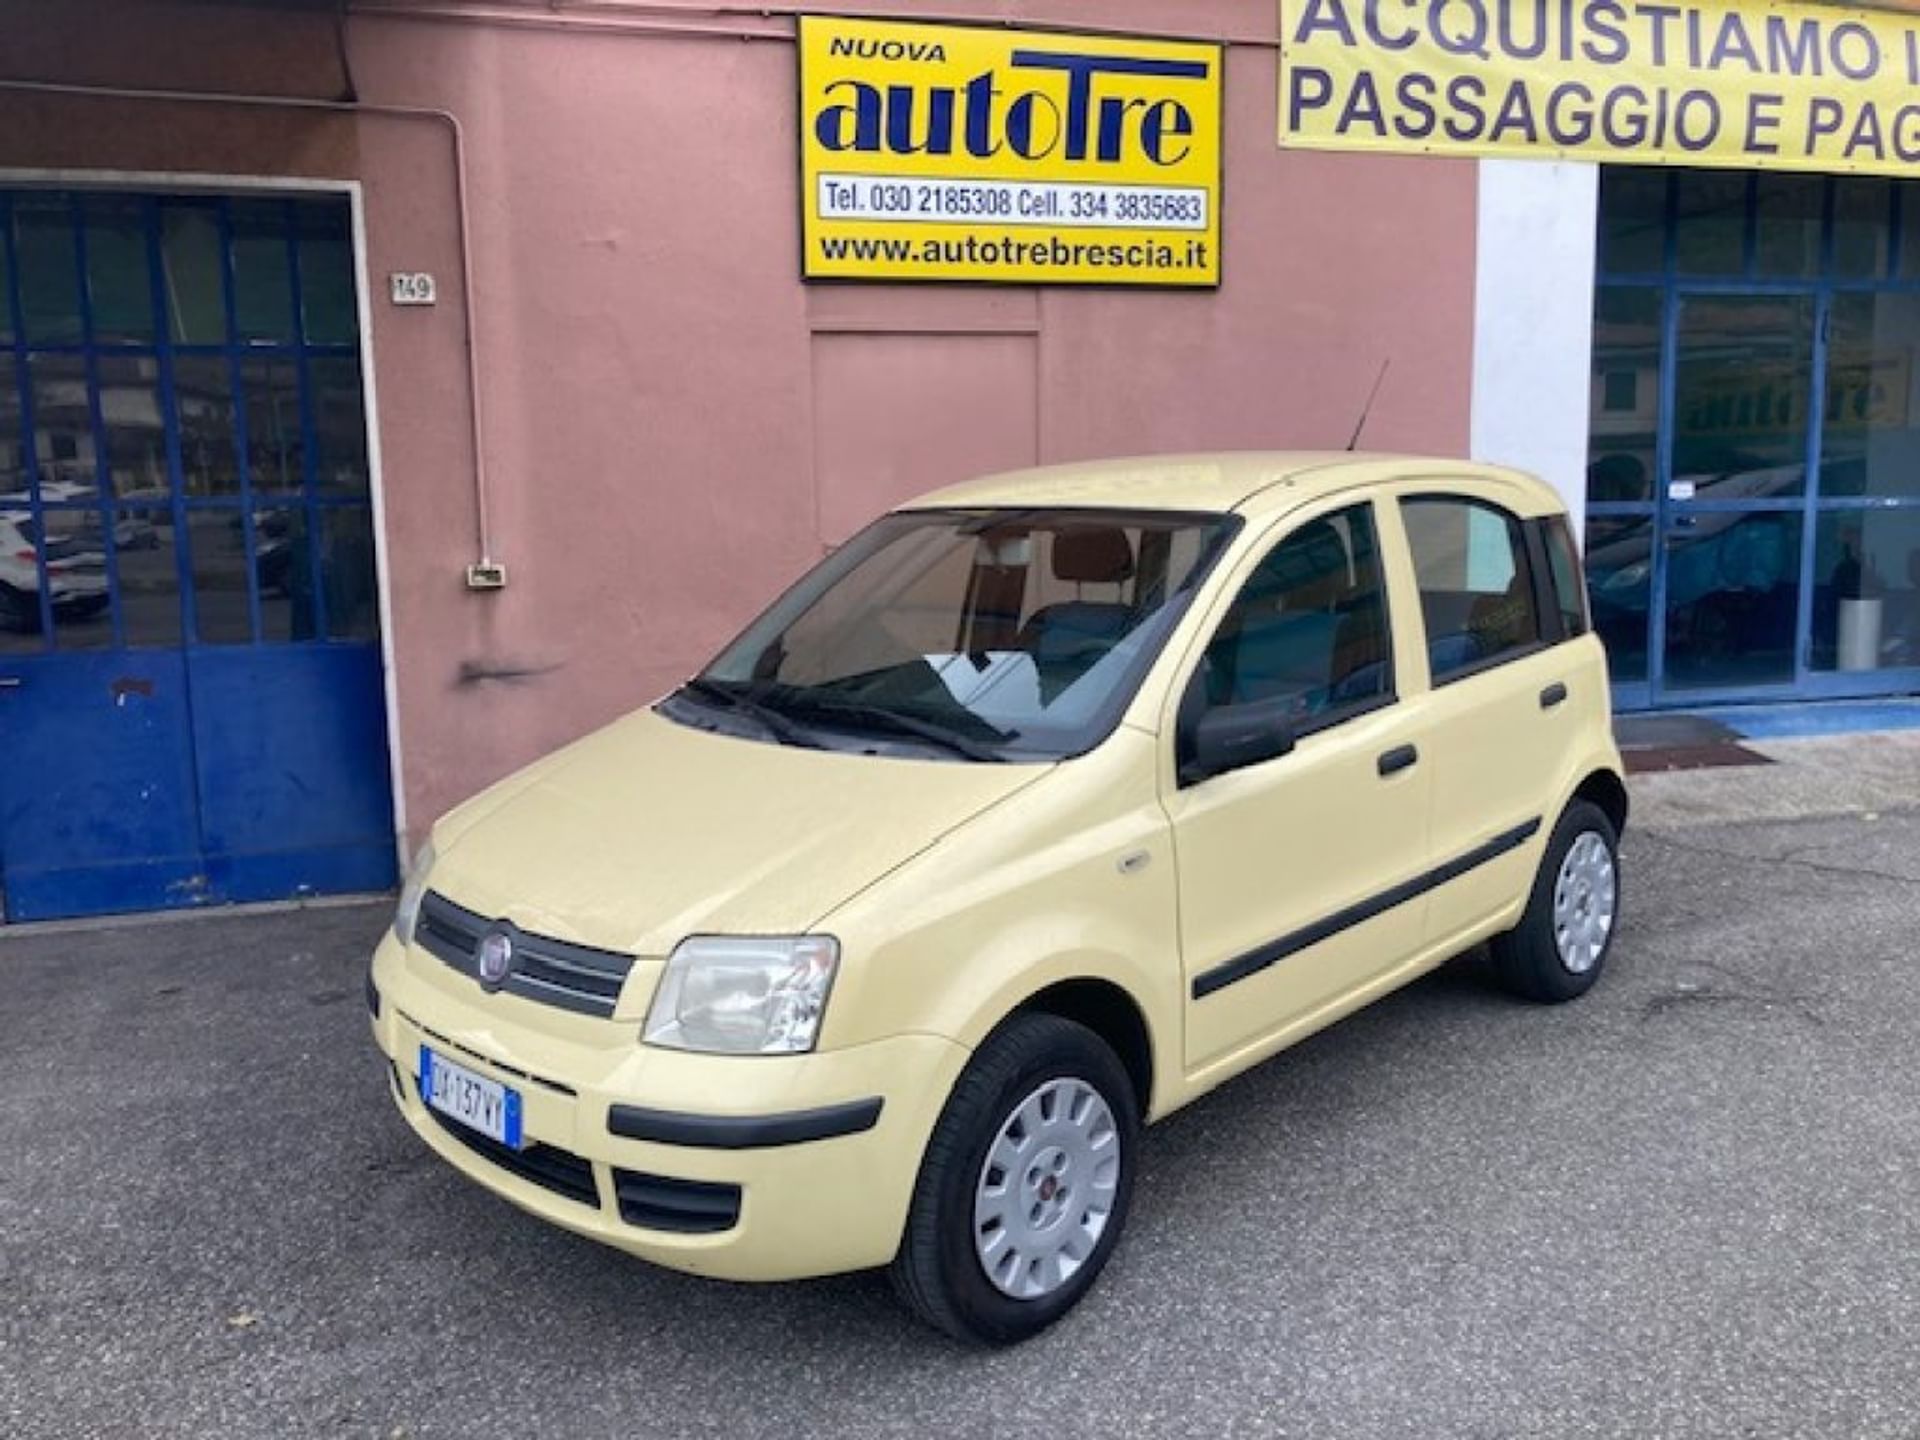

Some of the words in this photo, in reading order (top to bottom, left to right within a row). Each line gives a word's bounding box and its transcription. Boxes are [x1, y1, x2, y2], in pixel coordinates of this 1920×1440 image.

[829, 36, 947, 63] NUOVA
[1293, 0, 1881, 81] ACQUISTIAMO
[1289, 65, 1722, 152] PASSAGGIO
[1743, 92, 1784, 155] E
[1804, 97, 1920, 163] PAG
[825, 180, 866, 211] Tel.
[870, 184, 912, 212] 030
[918, 185, 1012, 215] 2185308
[1017, 189, 1064, 217] Cell.
[1070, 191, 1108, 218] 334
[1115, 193, 1201, 221] 3835683
[821, 234, 1208, 268] www.autotrebrescia.it
[395, 277, 430, 299] 149
